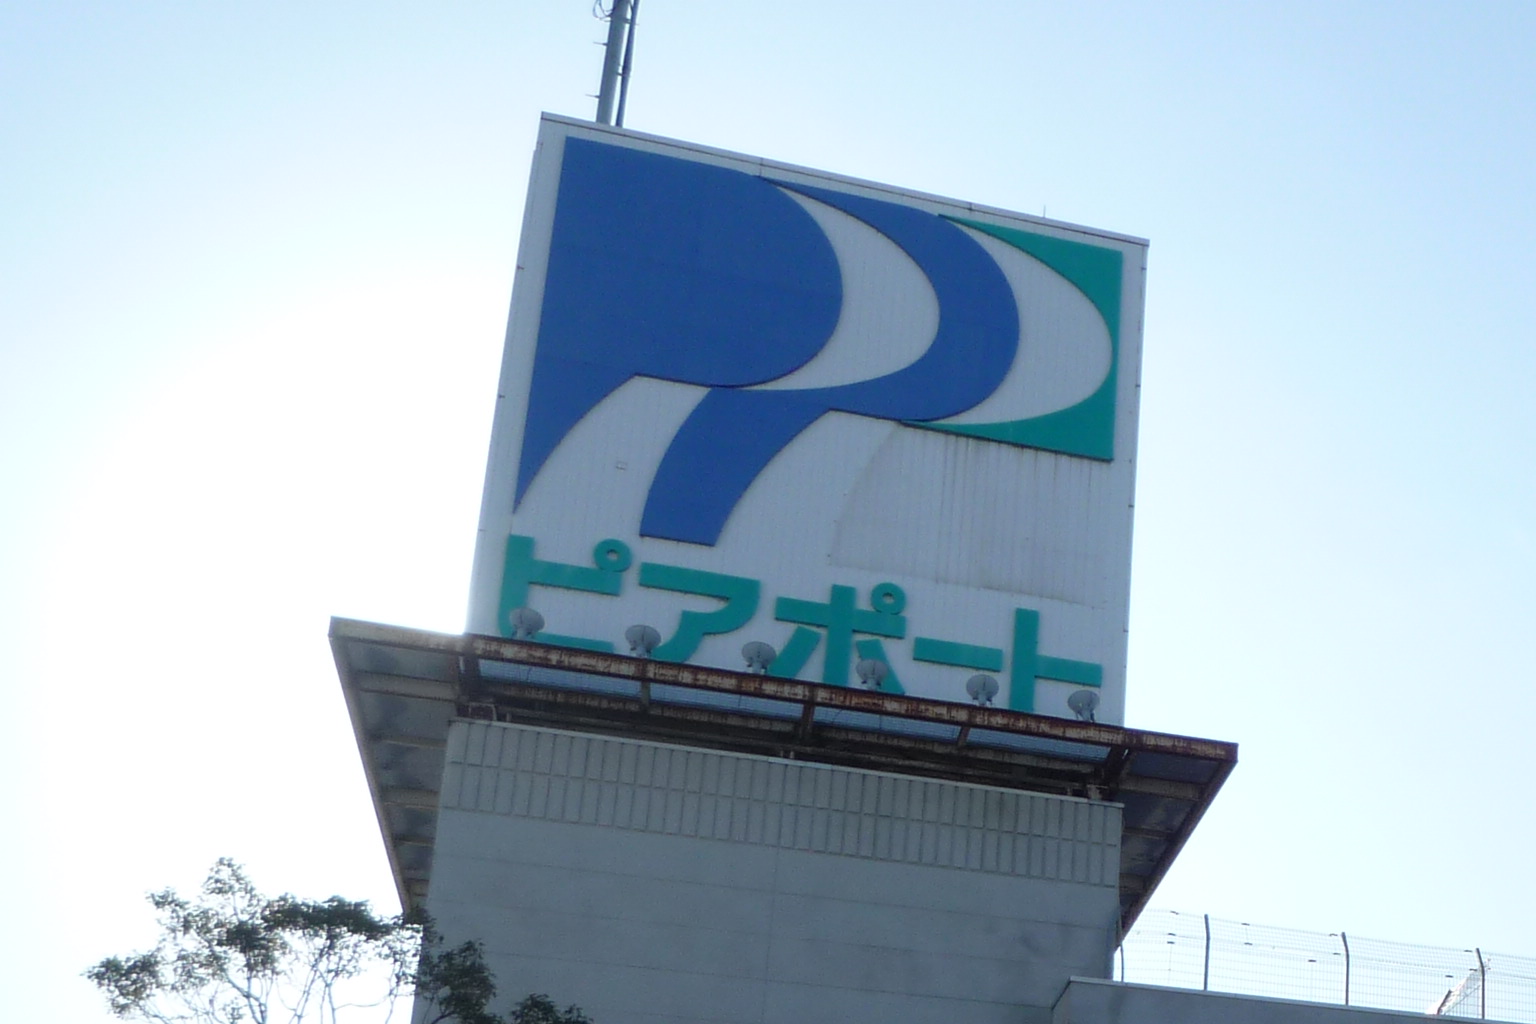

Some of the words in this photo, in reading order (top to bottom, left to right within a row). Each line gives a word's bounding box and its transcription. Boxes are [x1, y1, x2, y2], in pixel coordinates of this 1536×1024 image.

[498, 533, 1102, 712] ピアポート
